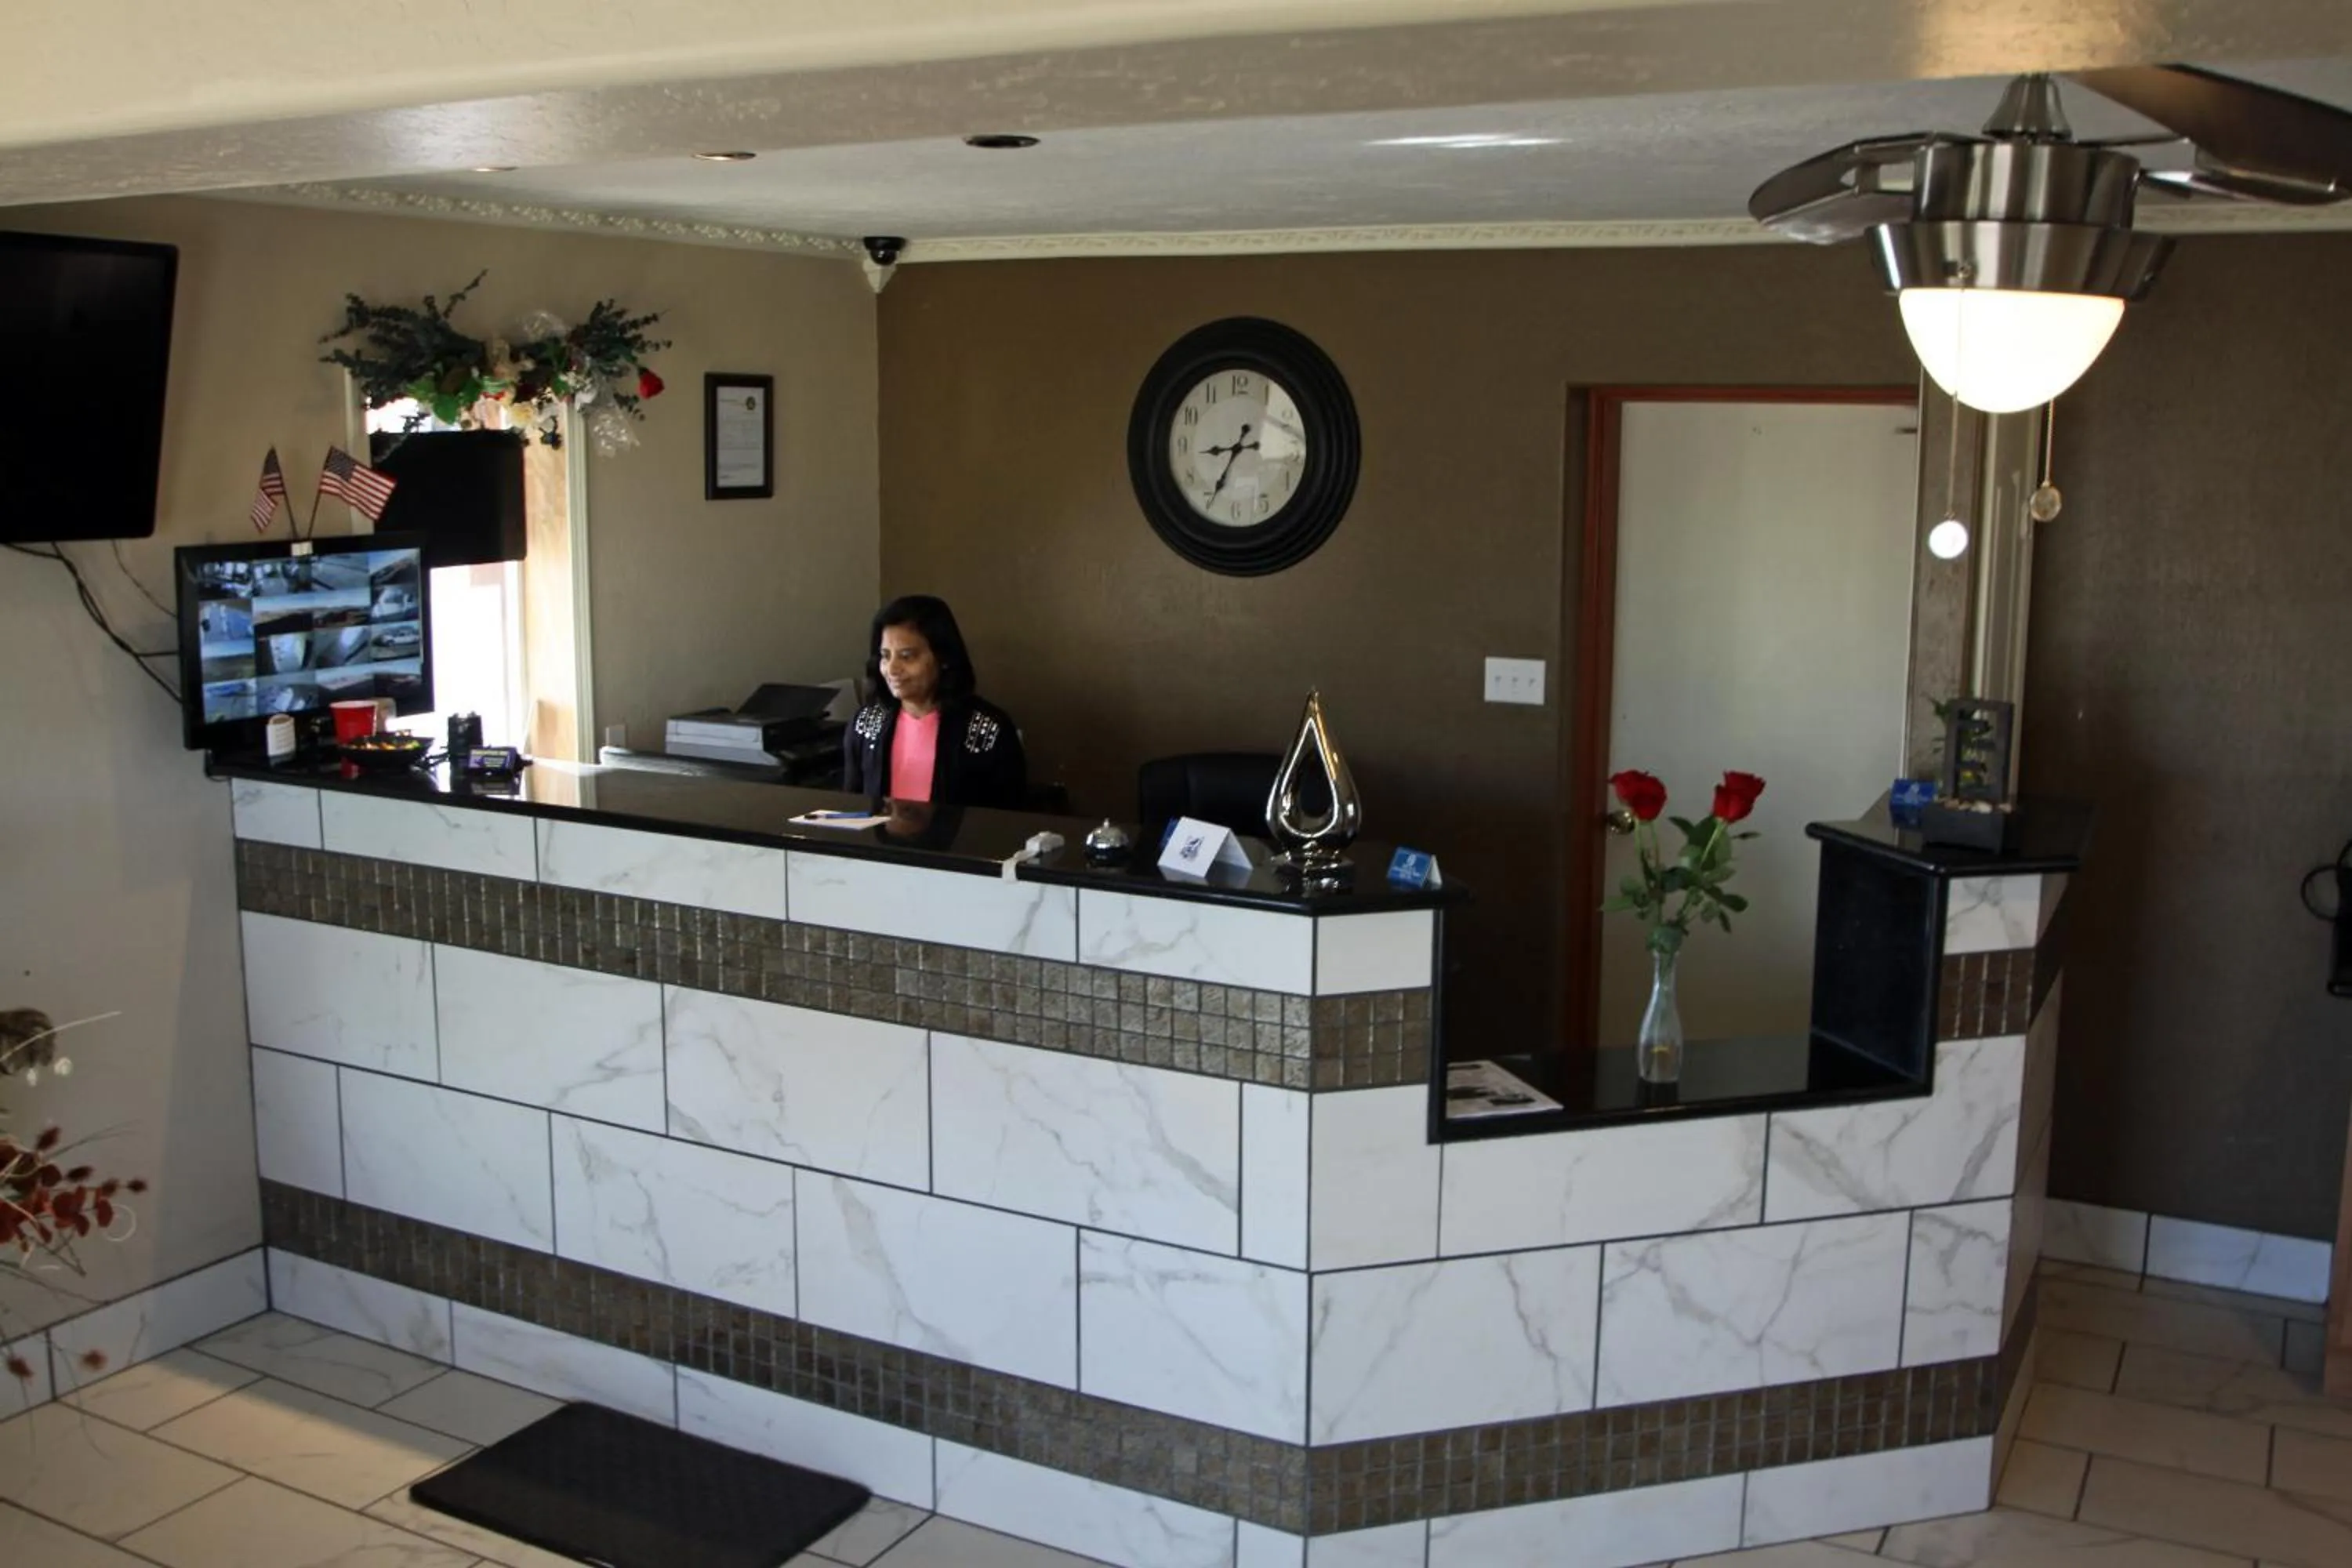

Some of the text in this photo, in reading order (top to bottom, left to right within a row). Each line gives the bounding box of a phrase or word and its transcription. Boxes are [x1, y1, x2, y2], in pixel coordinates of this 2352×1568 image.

[1205, 382, 1217, 403] 11
[1231, 375, 1249, 396] 12
[1264, 384, 1269, 405] 1
[1184, 405, 1199, 426] 10
[1177, 434, 1188, 456] 9
[1230, 500, 1241, 520] 6
[1258, 492, 1270, 514] 5
